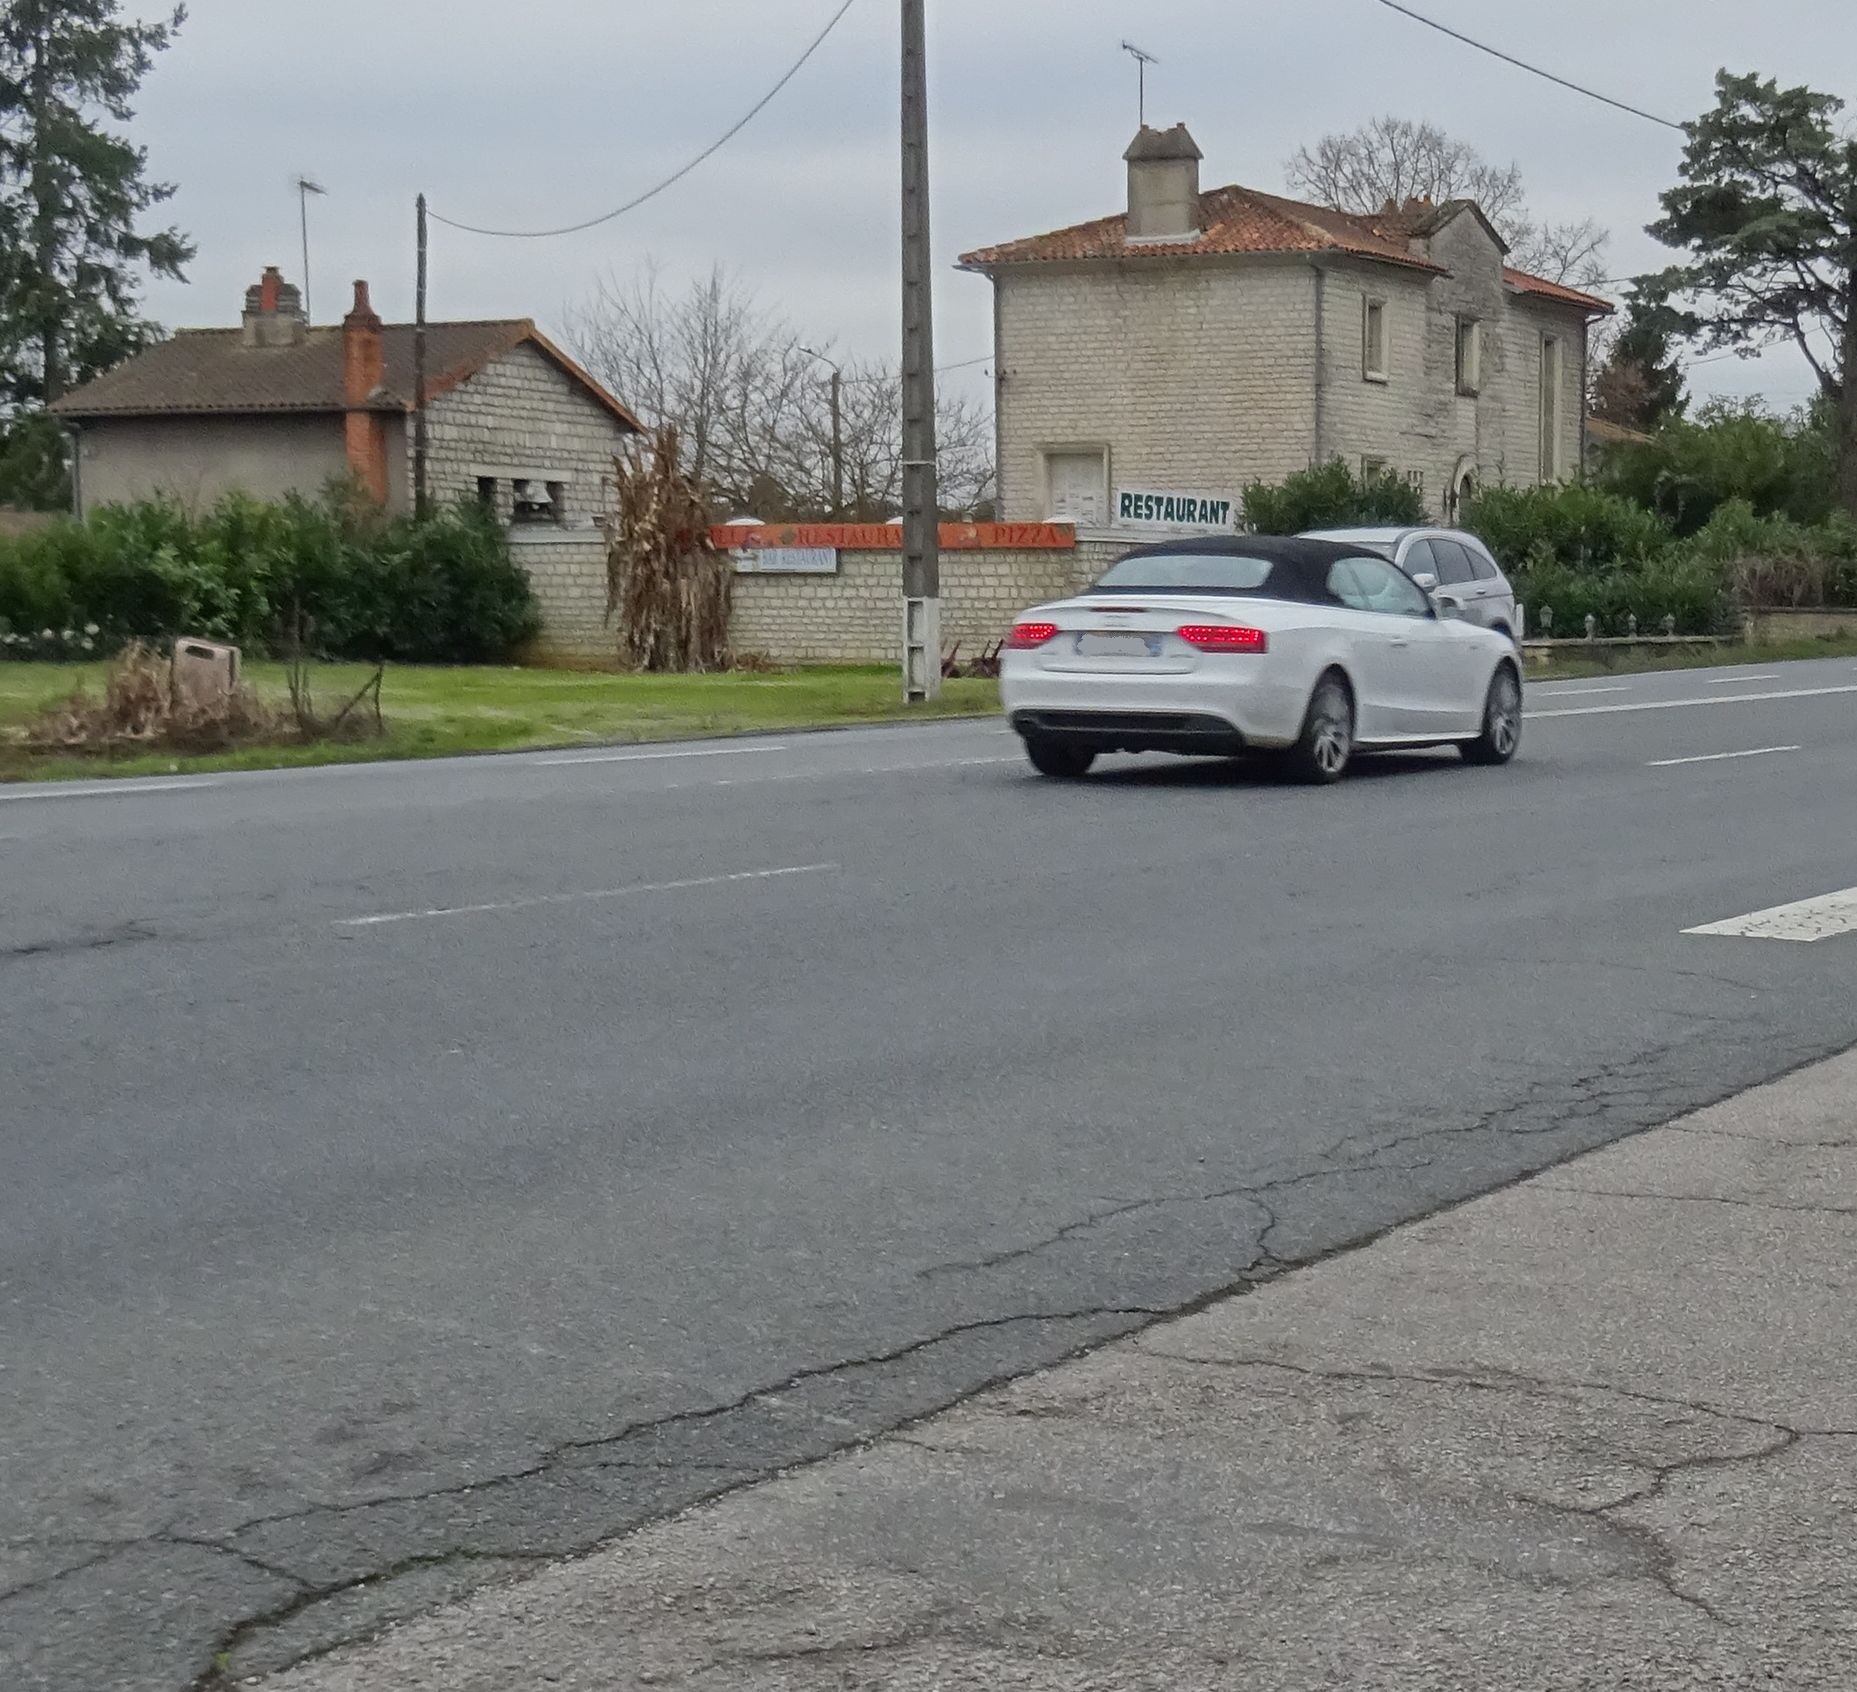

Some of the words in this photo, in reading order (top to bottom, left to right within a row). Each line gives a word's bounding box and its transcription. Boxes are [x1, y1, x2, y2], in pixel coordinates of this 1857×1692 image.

[1120, 492, 1230, 525] RESTAURANT
[798, 527, 903, 546] RESTAURA
[993, 526, 1057, 544] PIZZA
